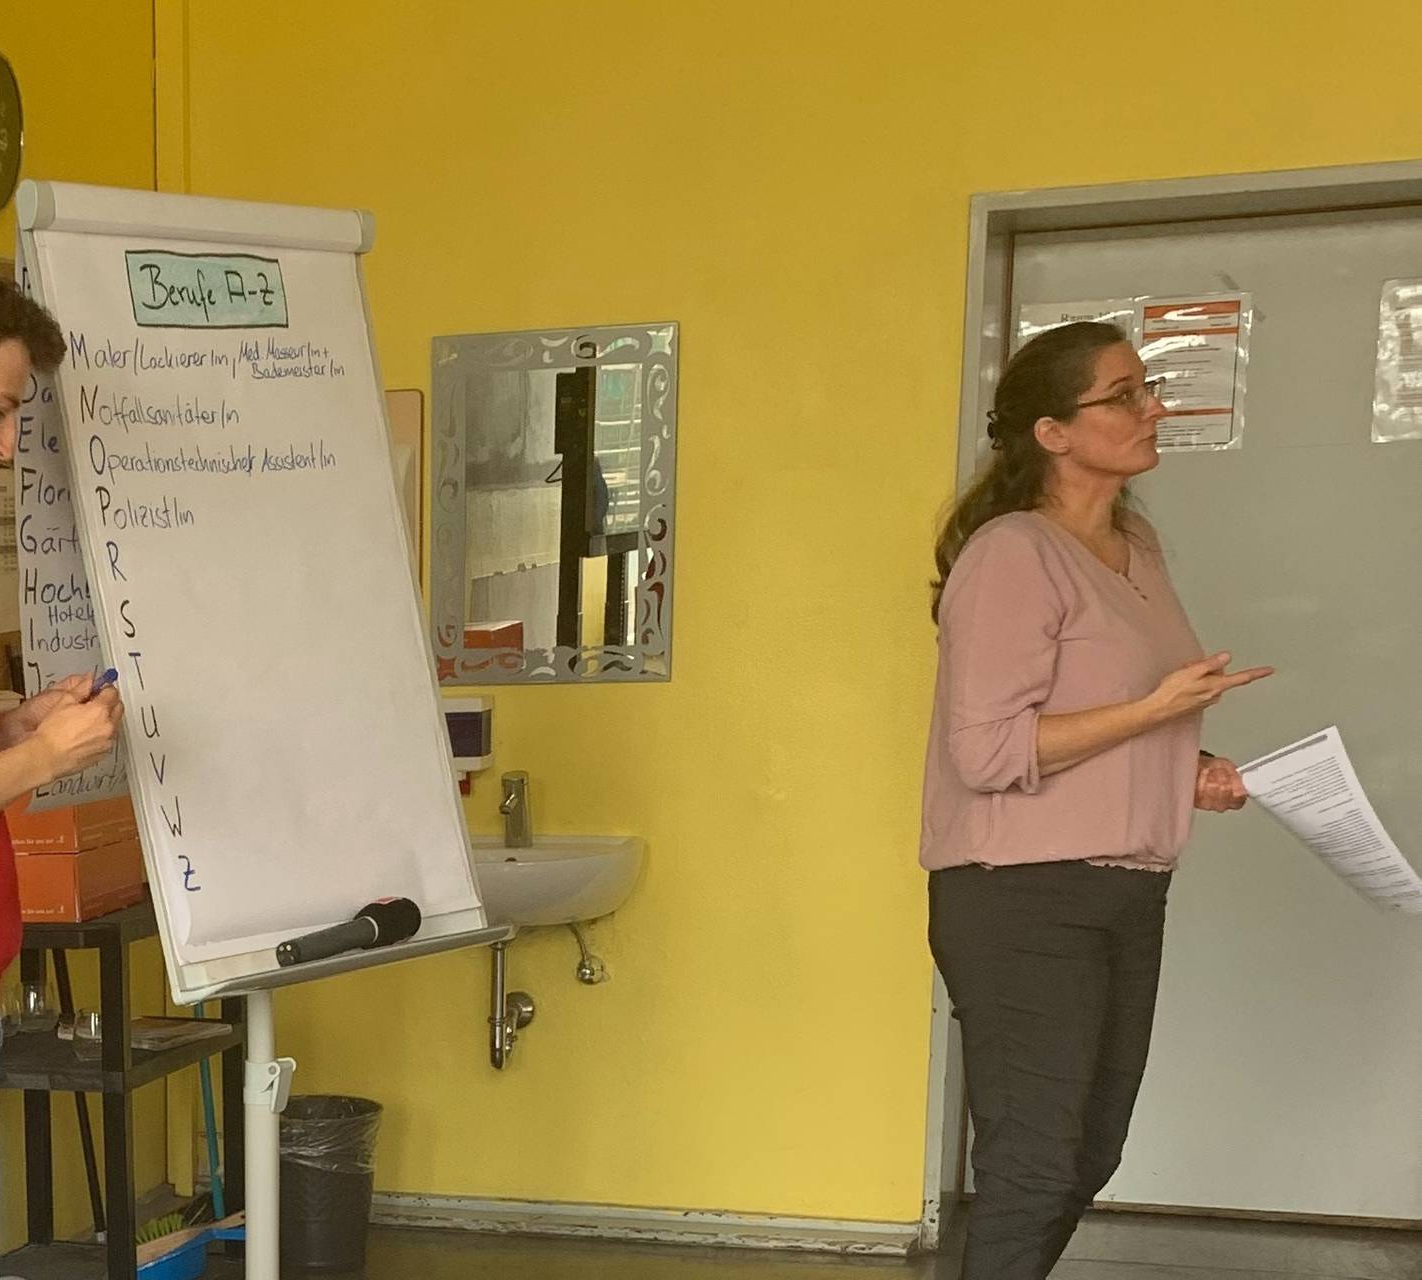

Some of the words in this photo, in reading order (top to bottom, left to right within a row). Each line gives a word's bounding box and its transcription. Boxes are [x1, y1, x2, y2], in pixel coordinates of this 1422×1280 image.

[139, 263, 217, 323] Berufe
[224, 269, 276, 307] A-Z
[106, 540, 128, 582] R
[120, 599, 137, 639] S
[128, 651, 146, 691] T
[140, 704, 161, 739] U
[149, 751, 167, 786] V
[160, 795, 183, 838] W
[177, 854, 202, 892] Z
